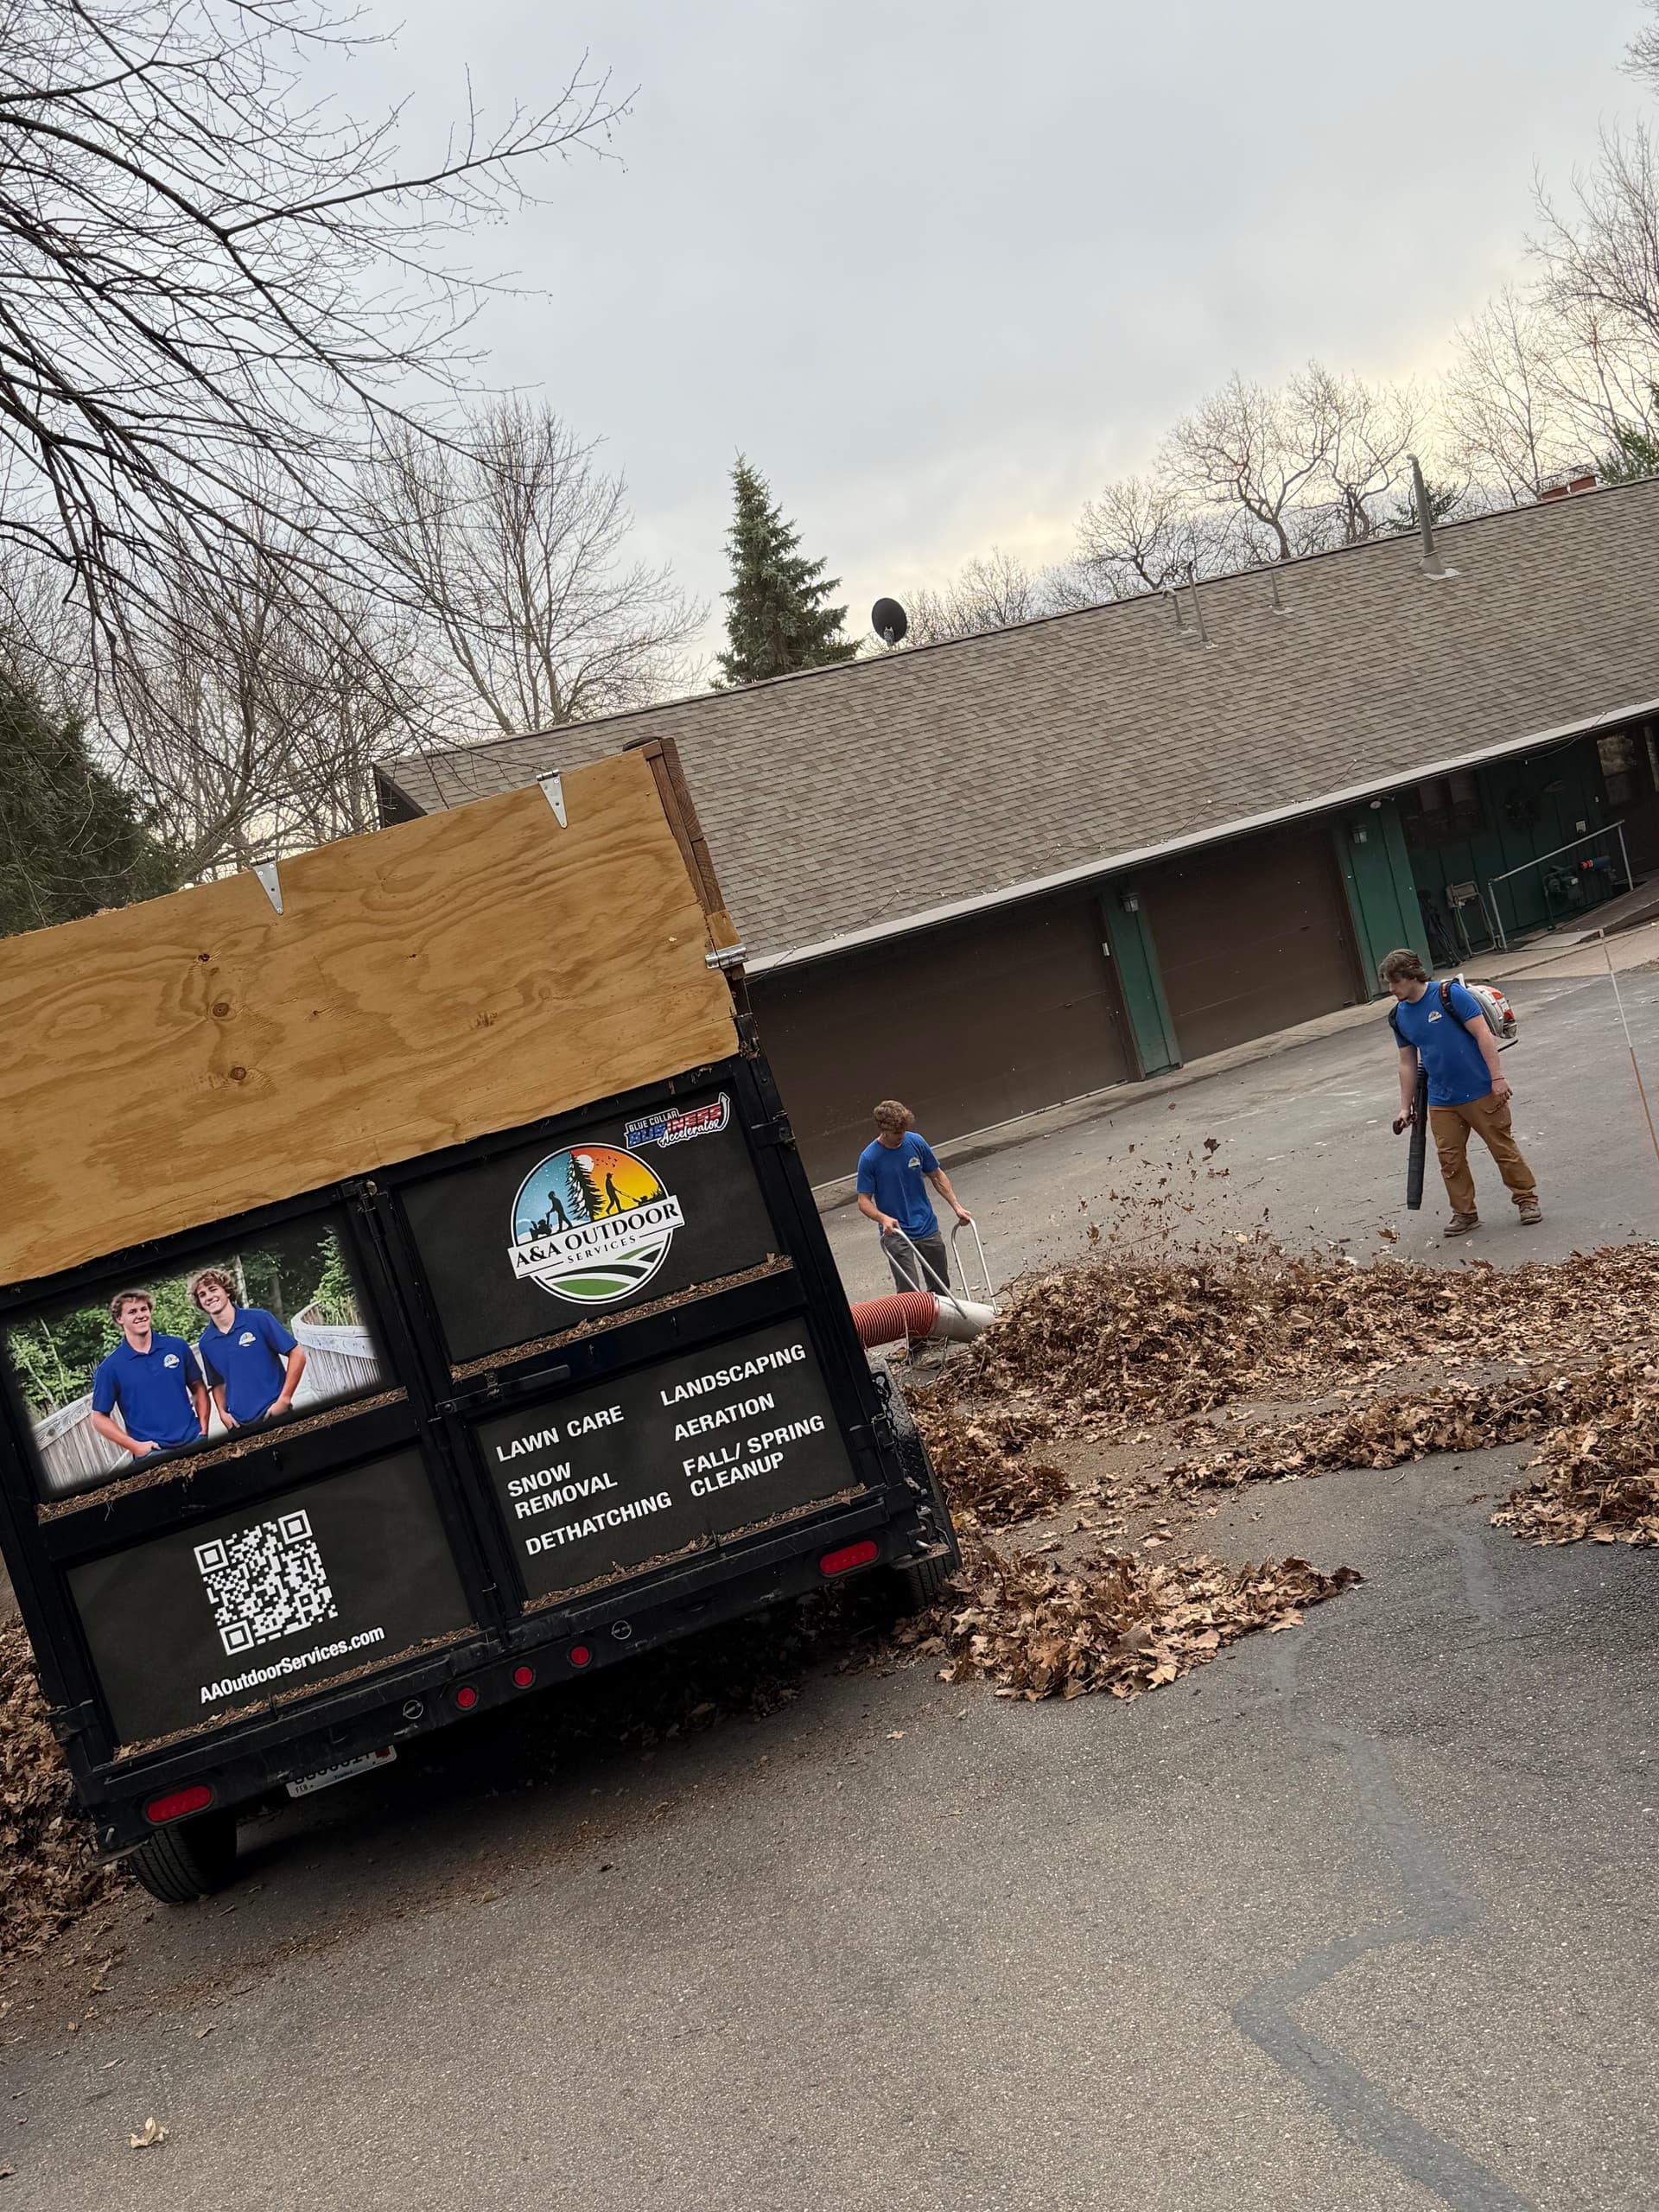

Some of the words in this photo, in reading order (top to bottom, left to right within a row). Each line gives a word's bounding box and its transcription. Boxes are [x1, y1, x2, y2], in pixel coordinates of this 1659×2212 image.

[629, 1121, 649, 1133] BLUE
[649, 1110, 677, 1126] COLLAR
[517, 1242, 562, 1268] A&A
[564, 1203, 678, 1250] OUTDOOR
[568, 1235, 636, 1264] SERVICES
[660, 1344, 806, 1407] LANDSCAPING
[496, 1427, 560, 1462] LAWN
[566, 1405, 625, 1439] CARE
[674, 1393, 776, 1441] AERATION
[683, 1442, 741, 1477] FALL/
[747, 1415, 826, 1454] SPRING
[507, 1462, 572, 1497] SNOW
[514, 1472, 618, 1519] REMOVAL
[690, 1452, 785, 1497] CLEANUP
[525, 1491, 672, 1555] DETHATCHING
[200, 1625, 385, 1704] AAOutdoorServices.com
